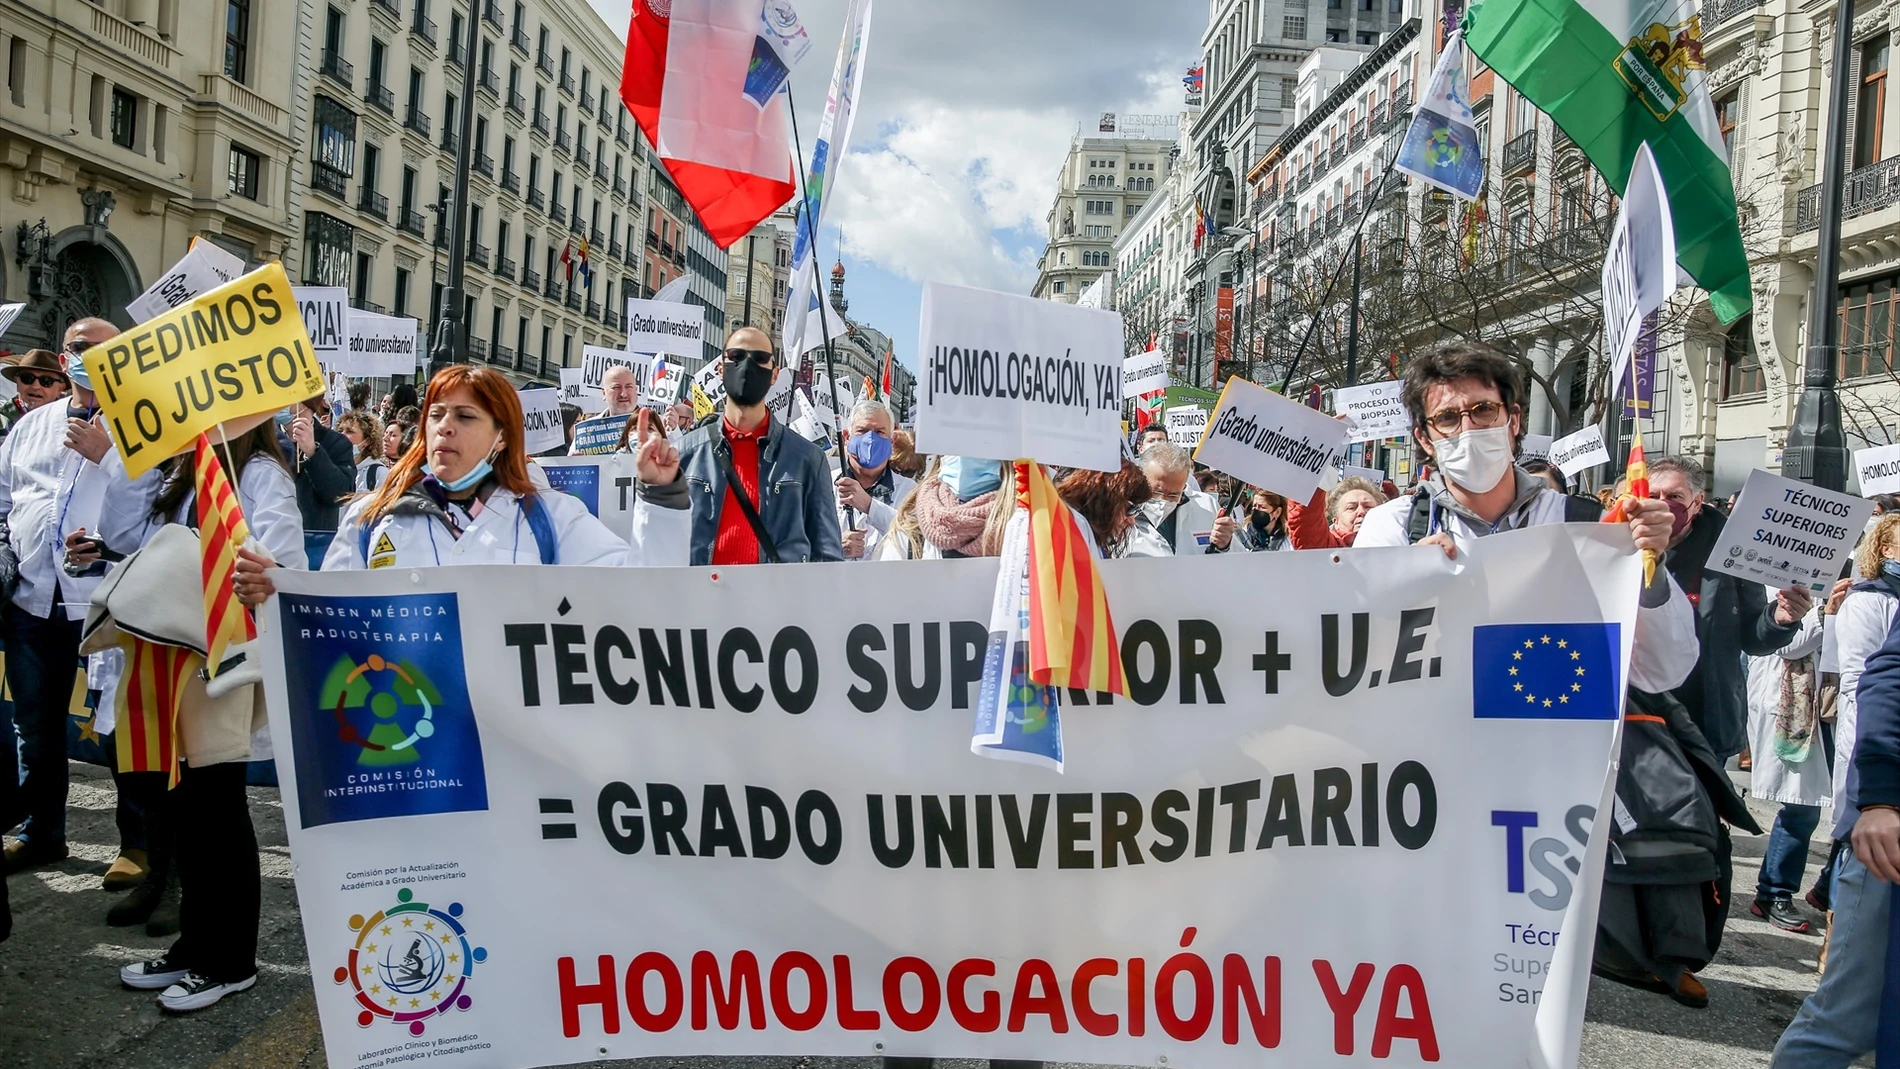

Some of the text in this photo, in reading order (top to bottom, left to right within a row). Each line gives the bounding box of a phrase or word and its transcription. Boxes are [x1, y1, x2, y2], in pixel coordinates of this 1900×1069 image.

[1630, 59, 1665, 101] POR ESPAÑA
[630, 313, 702, 340] ¡Grado universitario!
[98, 283, 282, 402] ¡PEDIMOS
[349, 333, 414, 354] ado universitario!
[928, 346, 1121, 416] ¡HOMOLOGACIÓN, YA!
[1123, 360, 1165, 385] Grado universitario!
[113, 339, 313, 458] LO JUSTO!
[1348, 398, 1389, 410] PROCESO
[1369, 388, 1382, 396] YO
[547, 409, 562, 427] YA!
[1360, 408, 1402, 420] BIOPSIAS
[579, 435, 595, 445] GRAU
[1209, 406, 1334, 475] ¡Grado universitario!
[1570, 435, 1603, 459] universitario!
[1783, 488, 1851, 518] TÉCNICOS
[1762, 507, 1848, 541] SUPERIORES
[1753, 528, 1837, 561] SANITARIOS
[291, 604, 447, 618] IMAGEN MÉDICA
[301, 629, 443, 642] RADIOTERAPIA
[363, 621, 370, 629] Y
[503, 596, 819, 715] TÉCNICO
[845, 618, 1226, 714] SUPOR
[1320, 606, 1442, 697] U.E.
[324, 779, 463, 797] INTERINSTITUCIONAL
[347, 768, 436, 784] COMISIÓN
[597, 781, 842, 866] GRADO
[866, 760, 1438, 870] UNIVERSITARIO
[340, 878, 383, 891] Académica
[392, 875, 416, 885] Grado
[417, 871, 466, 883] Universitario
[346, 861, 459, 880] Comisión por la Actualización
[557, 926, 1441, 1062] HOMOLOGACIÓN YA
[358, 1044, 403, 1061] Laboratorio
[404, 1039, 430, 1050] Clínico
[437, 1033, 478, 1046] Biomédico
[385, 1051, 425, 1066] Patológica
[427, 1049, 432, 1058] y
[433, 1042, 492, 1057] Citodiagnóstico
